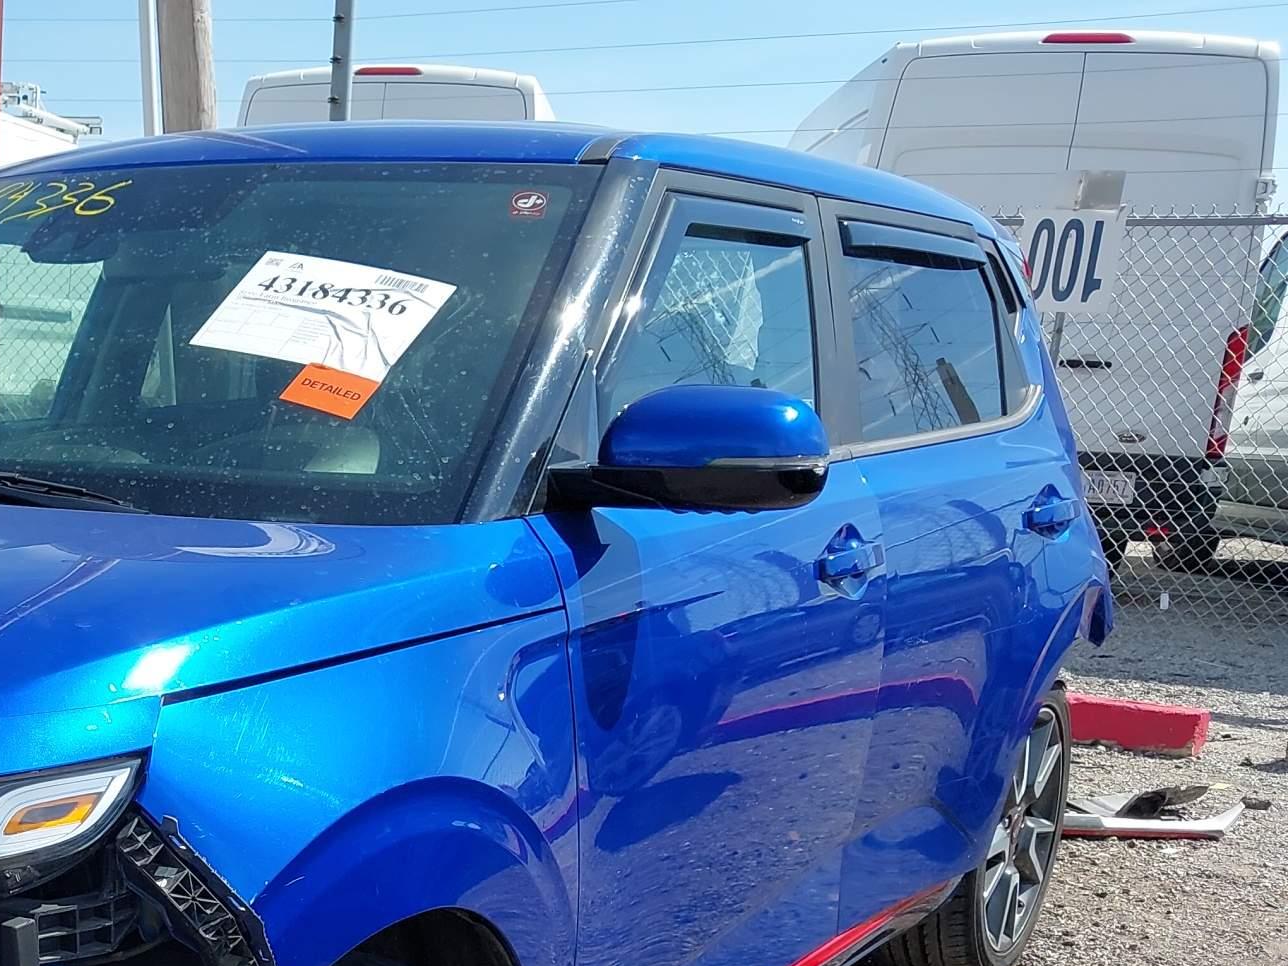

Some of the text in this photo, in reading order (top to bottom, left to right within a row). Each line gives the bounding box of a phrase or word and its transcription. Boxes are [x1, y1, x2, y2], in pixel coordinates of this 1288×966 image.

[1027, 218, 1105, 303] 100
[258, 275, 407, 316] 43184336
[301, 378, 361, 401] DETAILED
